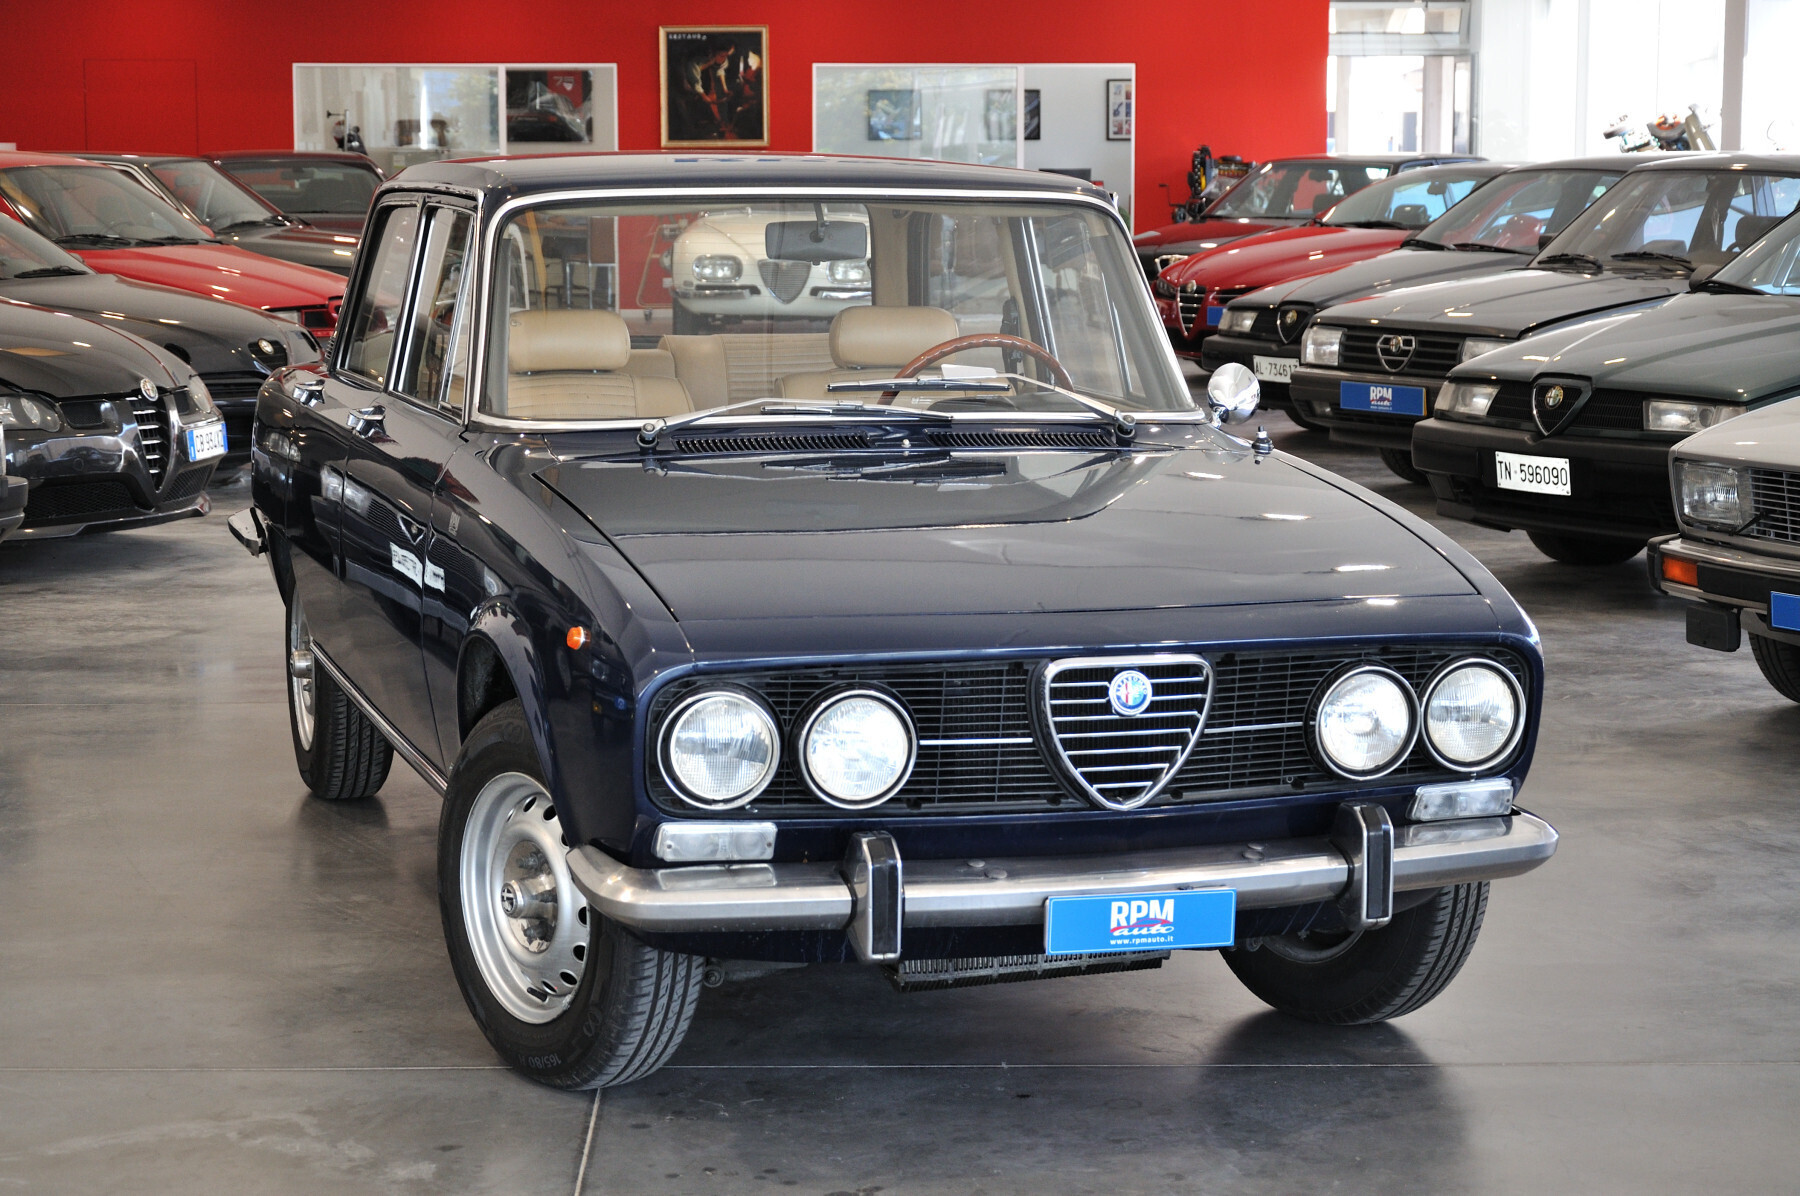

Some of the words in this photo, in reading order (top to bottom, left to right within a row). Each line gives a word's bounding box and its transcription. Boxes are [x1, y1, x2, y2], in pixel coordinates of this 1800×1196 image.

[1255, 361, 1264, 375] AL
[1369, 386, 1393, 401] RPM
[1498, 461, 1512, 480] TN
[1519, 463, 1568, 486] 596090
[1110, 899, 1175, 930] RPM
[1112, 923, 1175, 937] auto
[1110, 935, 1174, 946] www.rpmauto.it
[527, 1052, 562, 1069] 165/80
